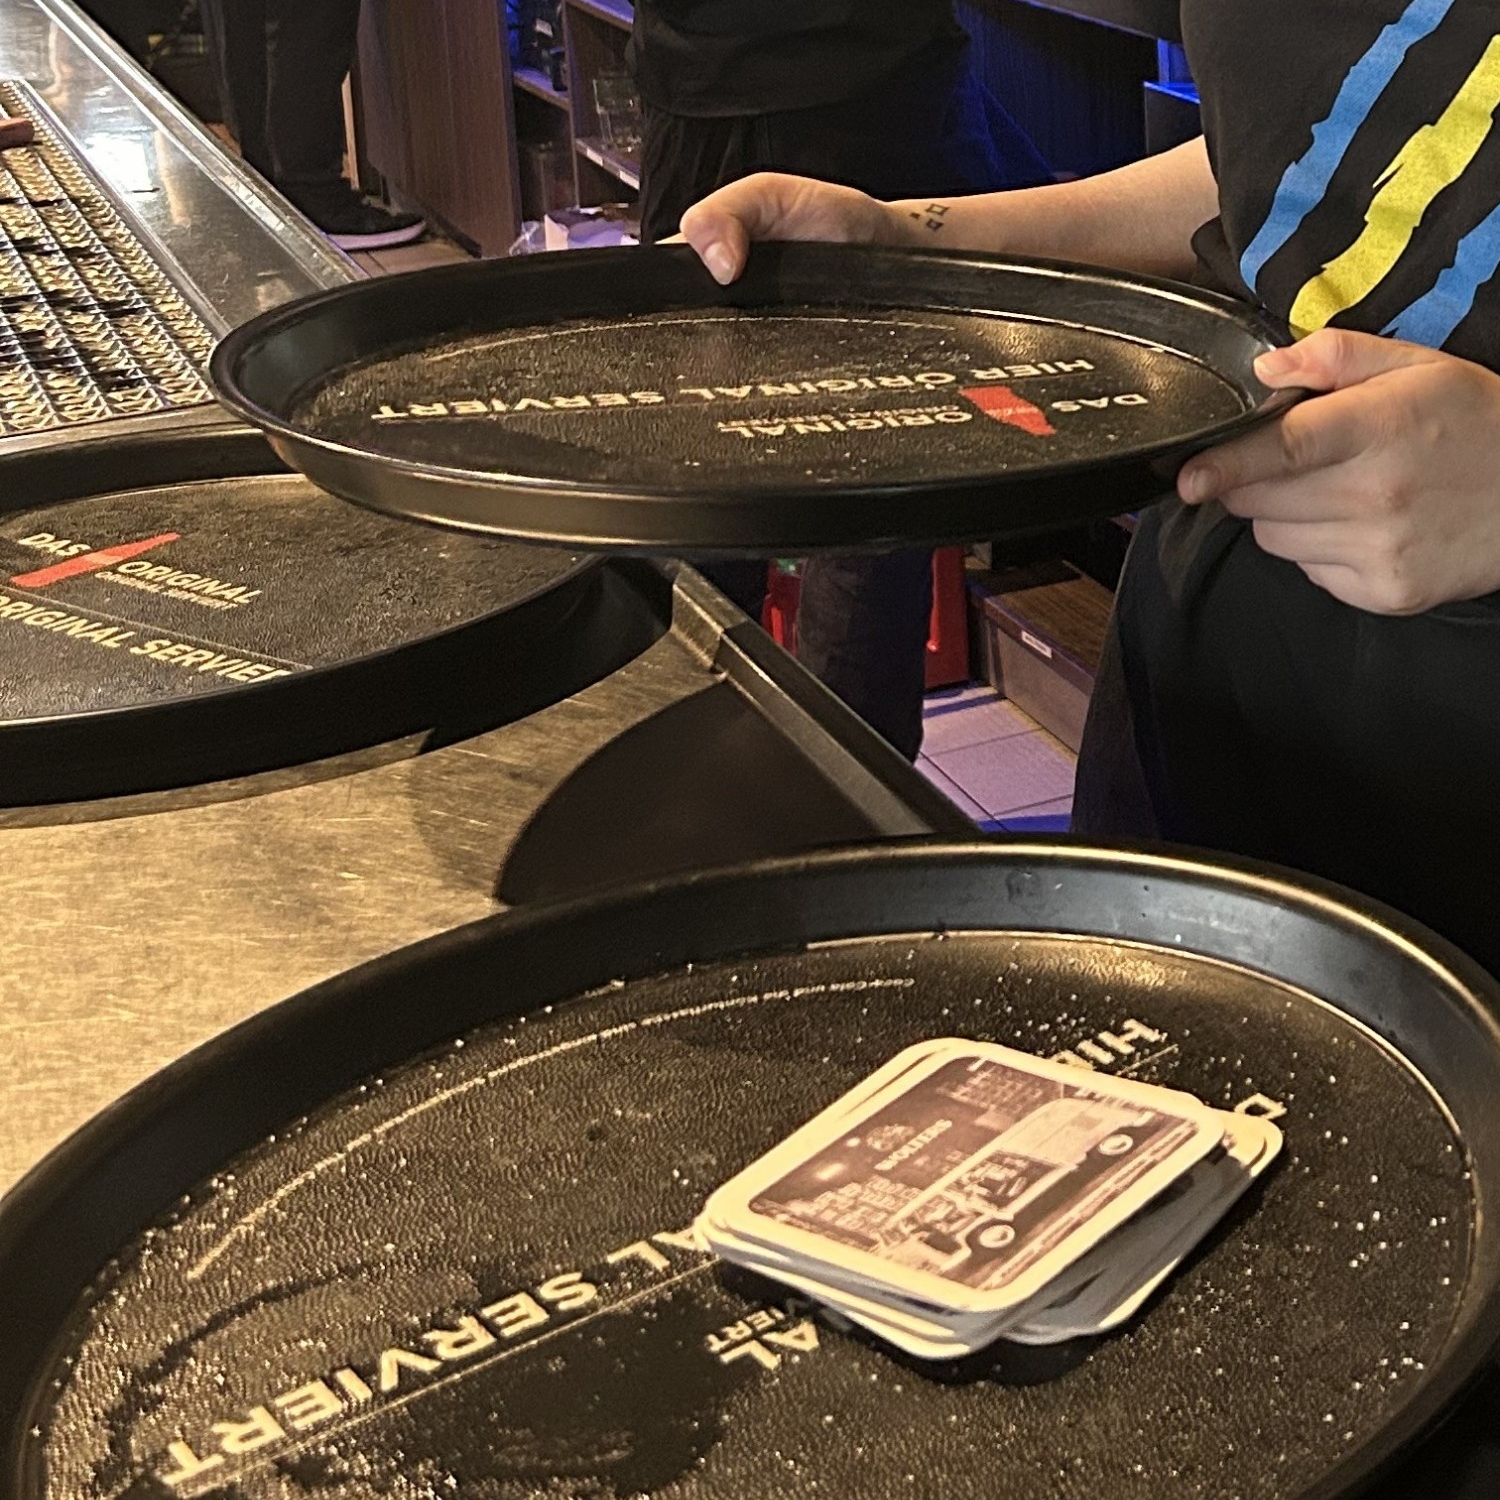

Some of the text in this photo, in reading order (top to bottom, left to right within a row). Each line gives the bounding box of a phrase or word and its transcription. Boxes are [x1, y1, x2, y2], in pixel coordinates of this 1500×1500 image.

[371, 359, 1095, 421] HIER ORIGINAL SERVIERT
[1051, 393, 1150, 413] DAS
[720, 409, 973, 439] ORIGINAL
[18, 532, 92, 557] DAS
[117, 560, 263, 604] ORIGINAL
[160, 1271, 600, 1488] SERVIERT
